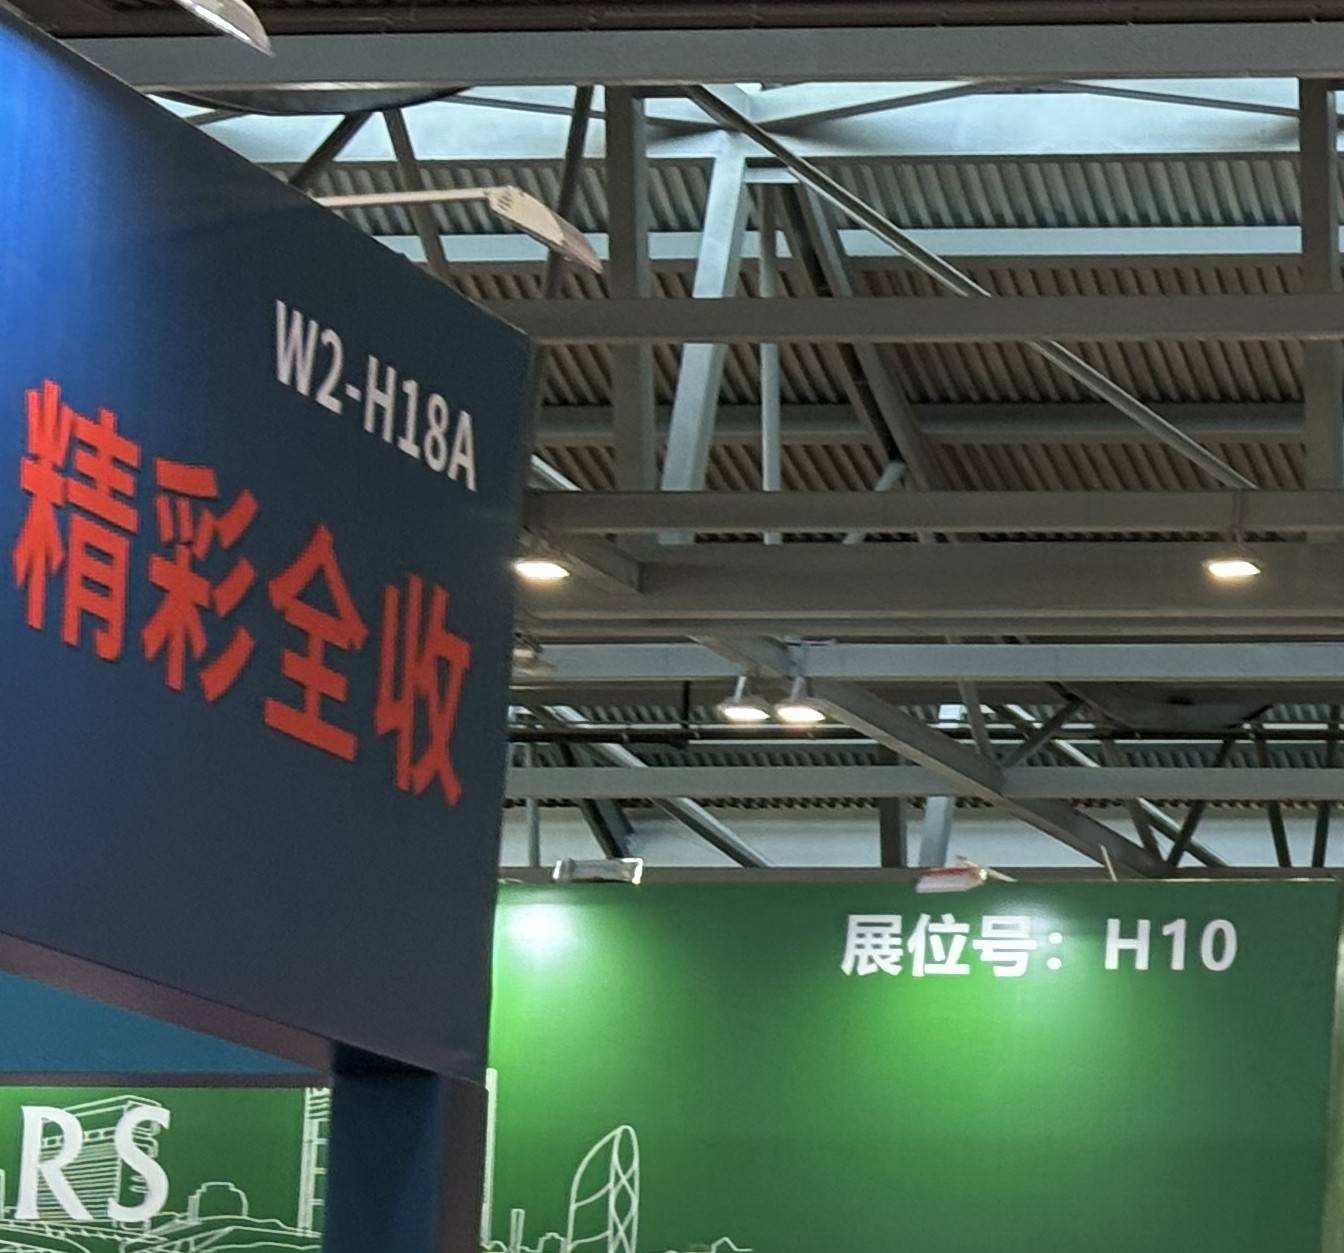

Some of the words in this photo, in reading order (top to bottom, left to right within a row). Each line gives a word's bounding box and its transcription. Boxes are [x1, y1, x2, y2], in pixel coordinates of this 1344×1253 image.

[275, 299, 478, 493] W2-H18A
[13, 378, 471, 807] 精彩全收
[14, 1104, 171, 1222] RS
